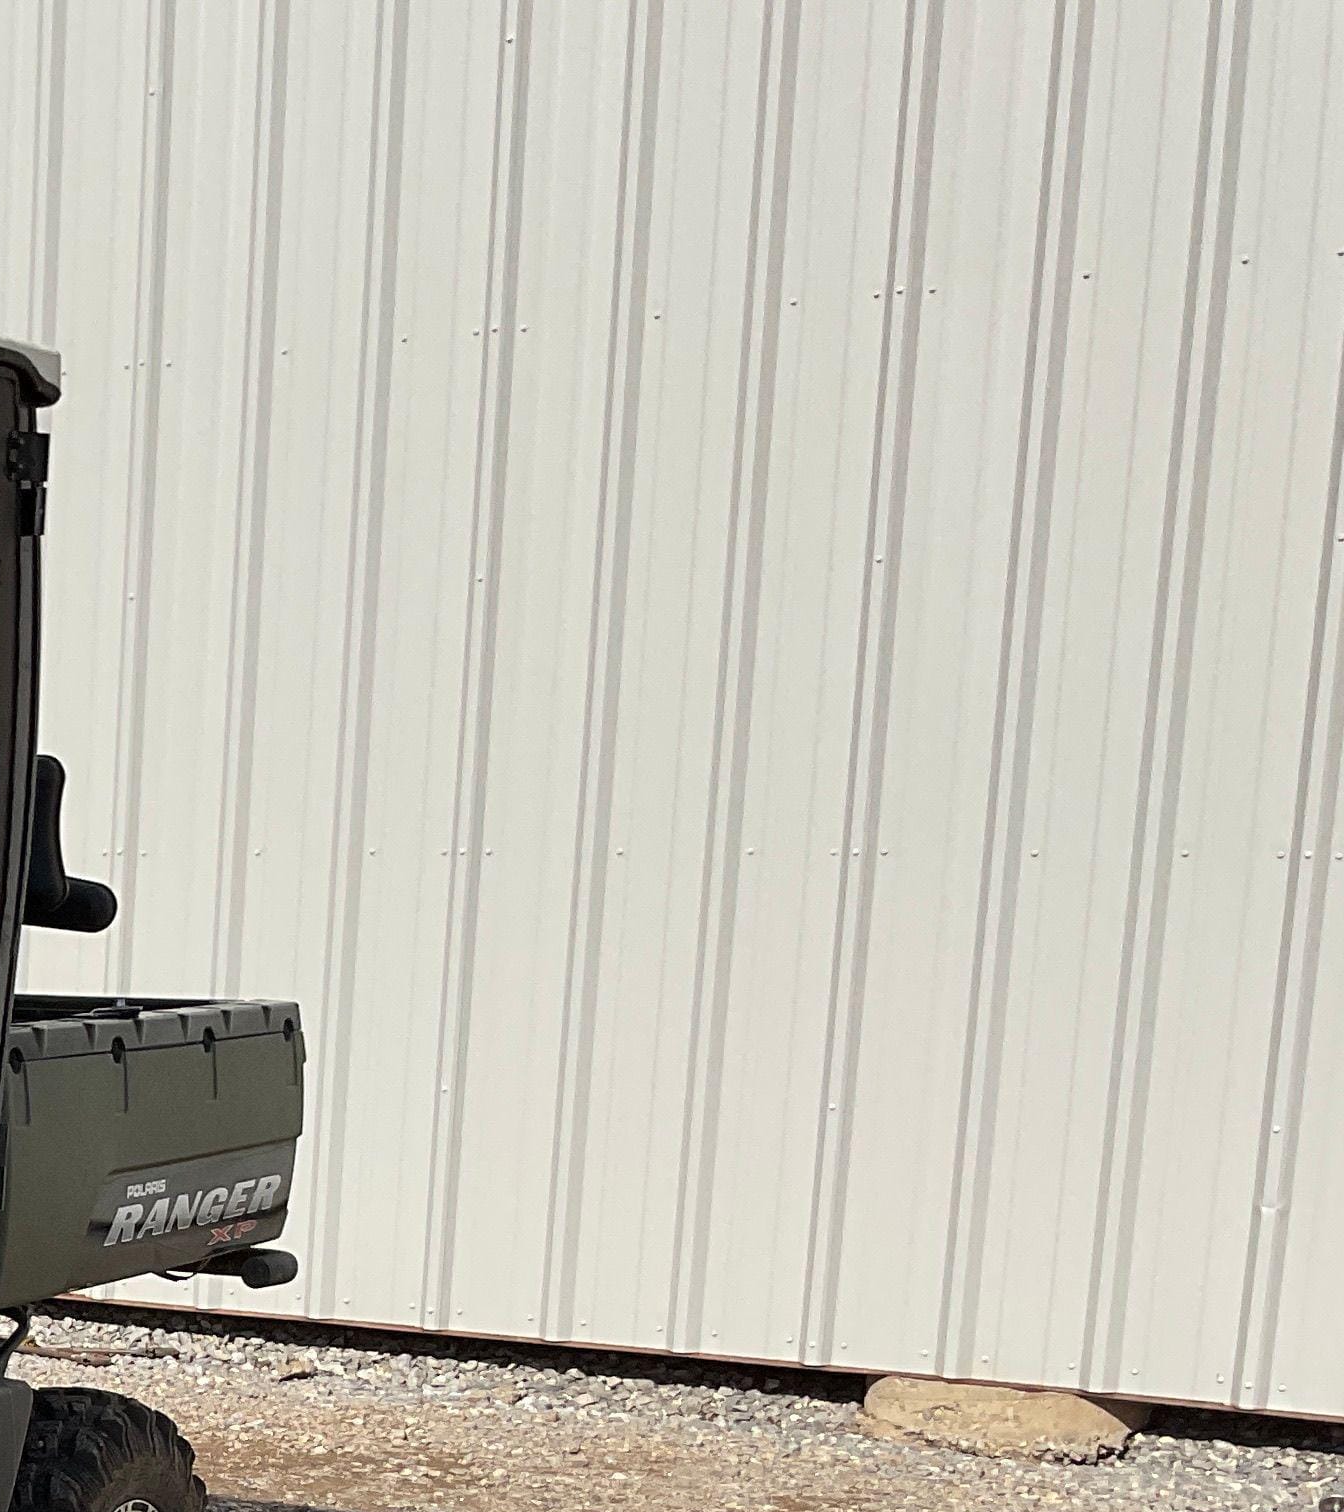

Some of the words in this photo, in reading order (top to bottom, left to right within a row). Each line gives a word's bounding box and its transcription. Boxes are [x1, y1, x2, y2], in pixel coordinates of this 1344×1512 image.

[126, 1179, 167, 1199] POLARIS
[103, 1174, 282, 1247] RANGER
[207, 1219, 257, 1246] XP
